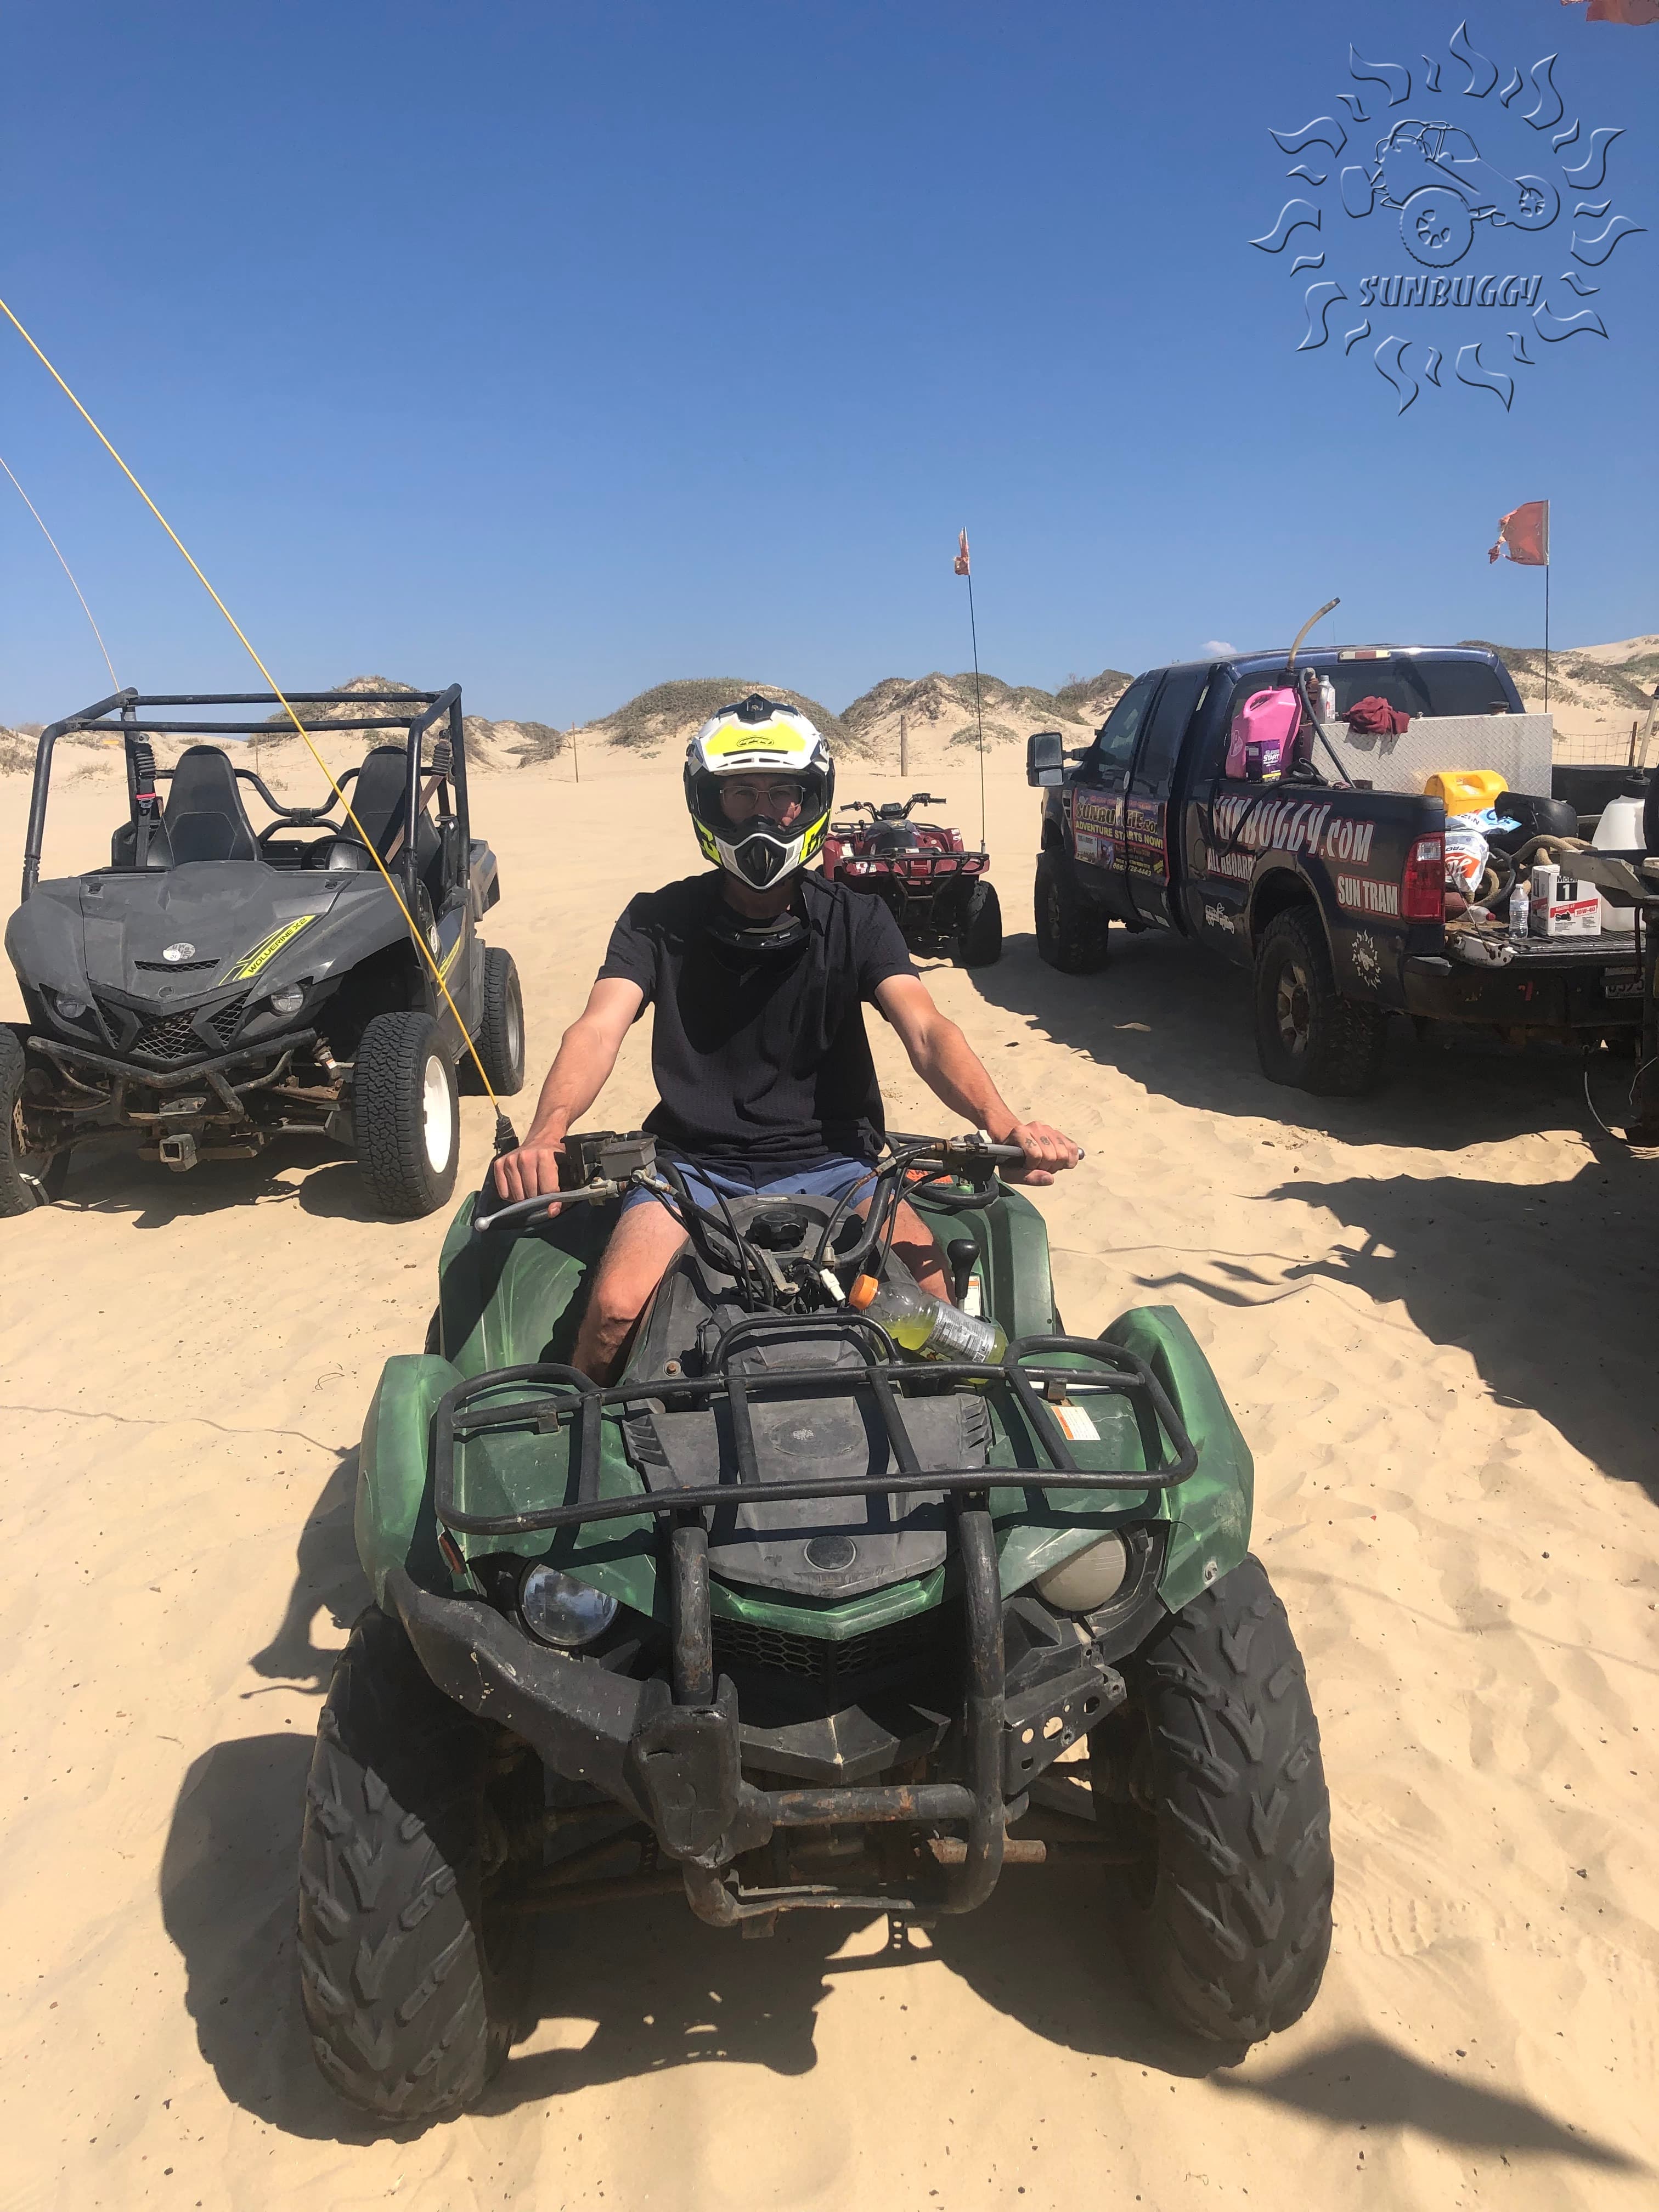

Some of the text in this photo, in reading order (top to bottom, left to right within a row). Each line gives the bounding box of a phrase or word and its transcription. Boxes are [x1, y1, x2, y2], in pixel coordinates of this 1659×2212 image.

[1076, 821, 1113, 838] ADVENTURE
[1144, 834, 1164, 849] NOW!
[1207, 848, 1221, 873] ALL
[1338, 876, 1398, 916] SUN TRAM
[1562, 883, 1570, 900] 1
[292, 918, 307, 930] X2
